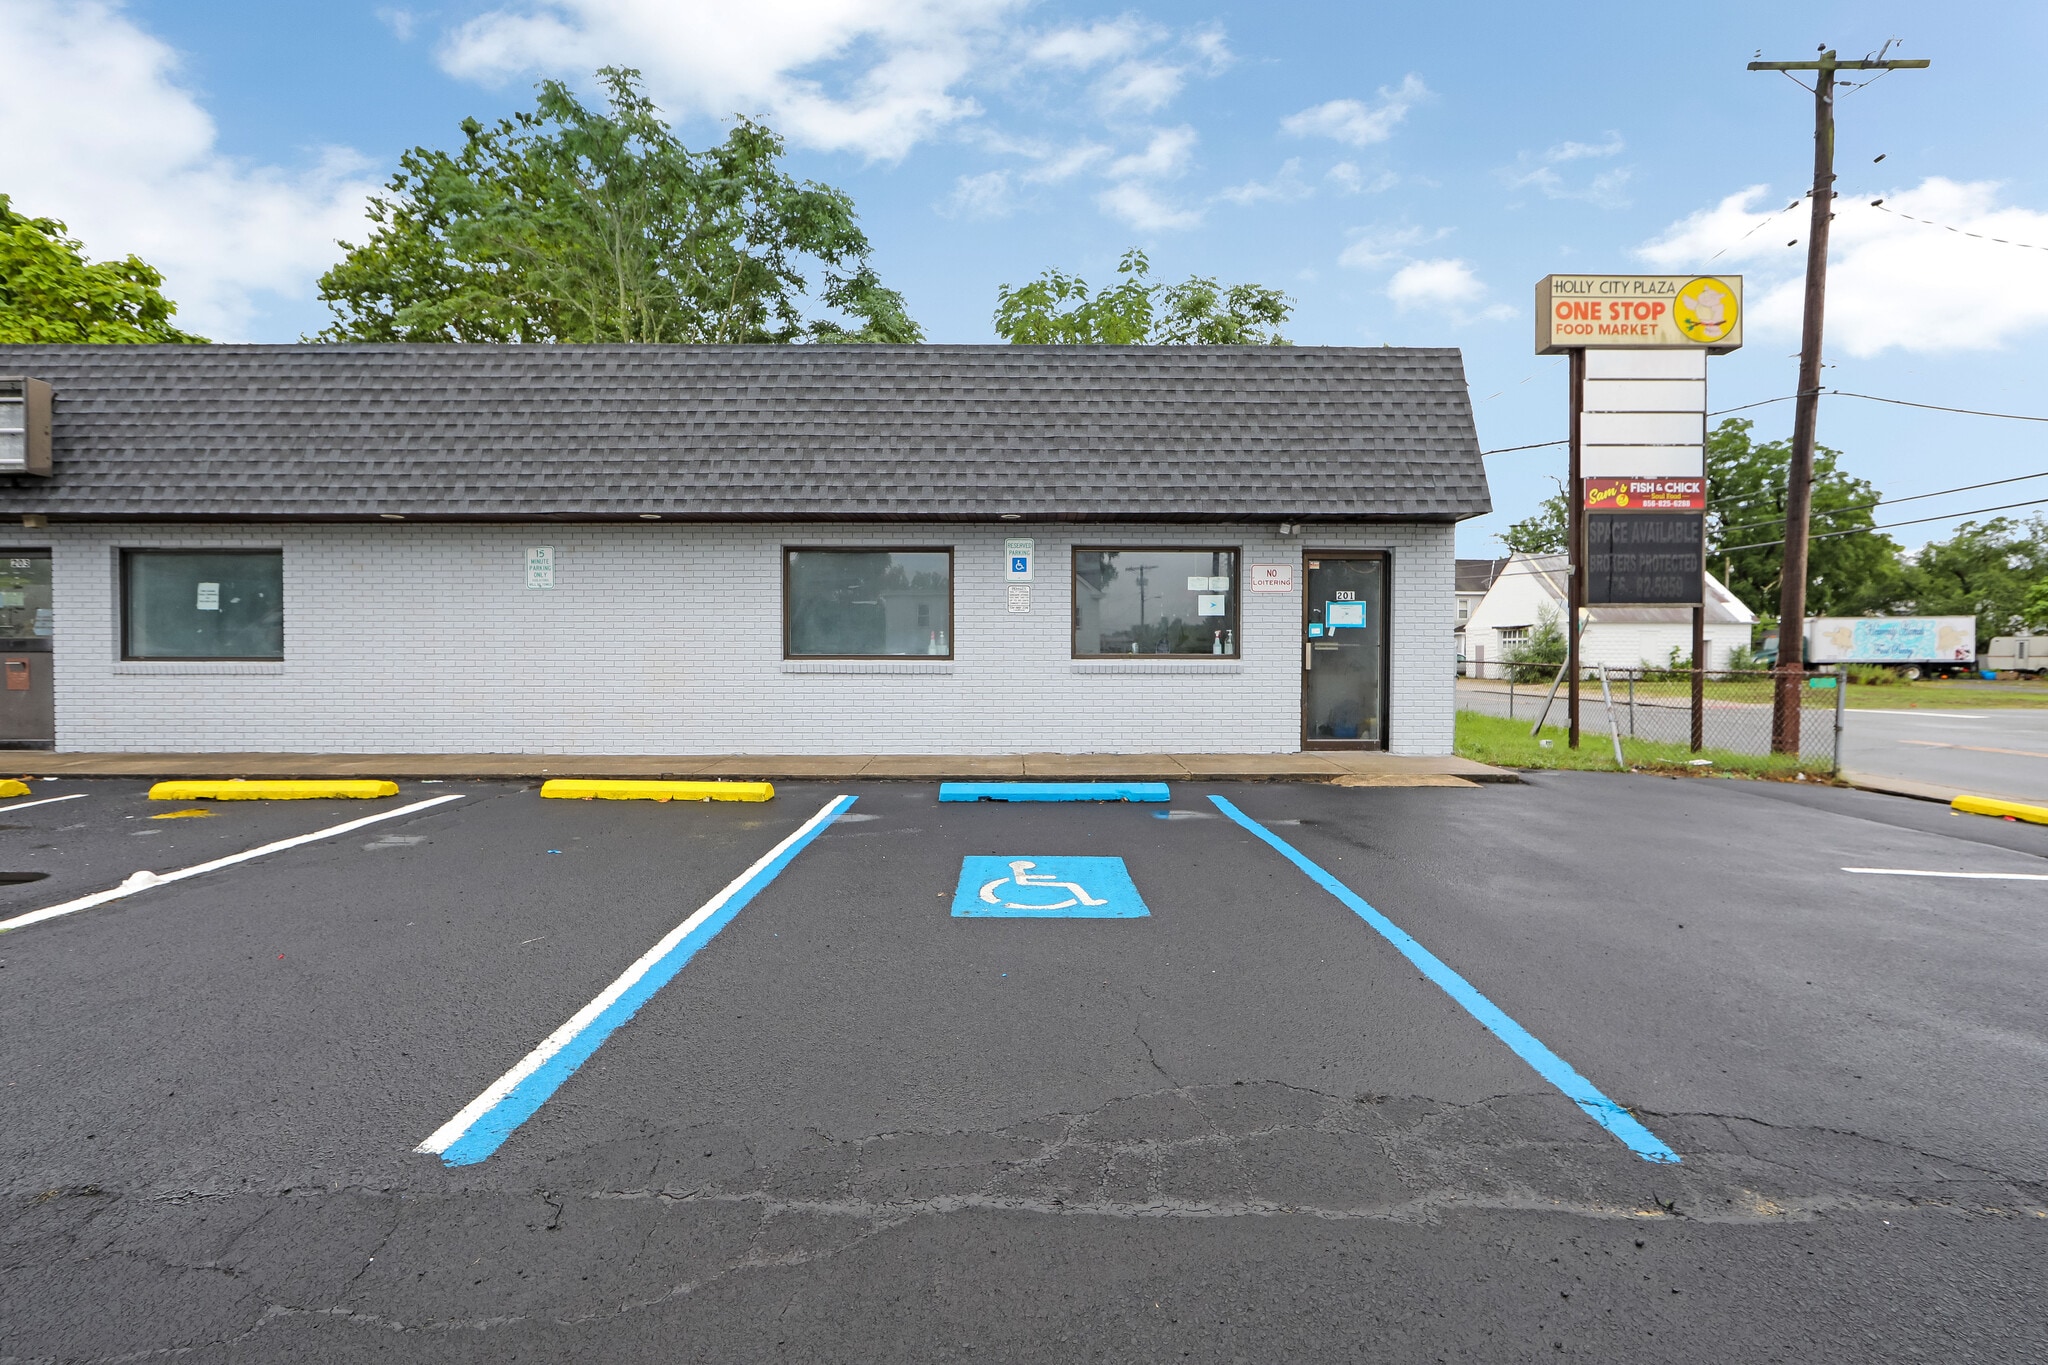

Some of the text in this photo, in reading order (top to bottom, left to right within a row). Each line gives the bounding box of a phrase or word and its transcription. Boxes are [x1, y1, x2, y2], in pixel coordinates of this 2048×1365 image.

[1553, 280, 1676, 294] HOLLY CITY PLAZA
[1555, 301, 1666, 321] ONE STOP
[1556, 323, 1658, 336] FOOD MARKET
[1588, 481, 1628, 505] Sam's
[1630, 482, 1700, 493] FISH & CHICK
[1589, 521, 1699, 544] SPACE AVAILABLE
[536, 549, 545, 558] 15
[1639, 553, 1698, 573] PROTECTED
[1266, 569, 1278, 578] NO
[1337, 591, 1353, 600] 201
